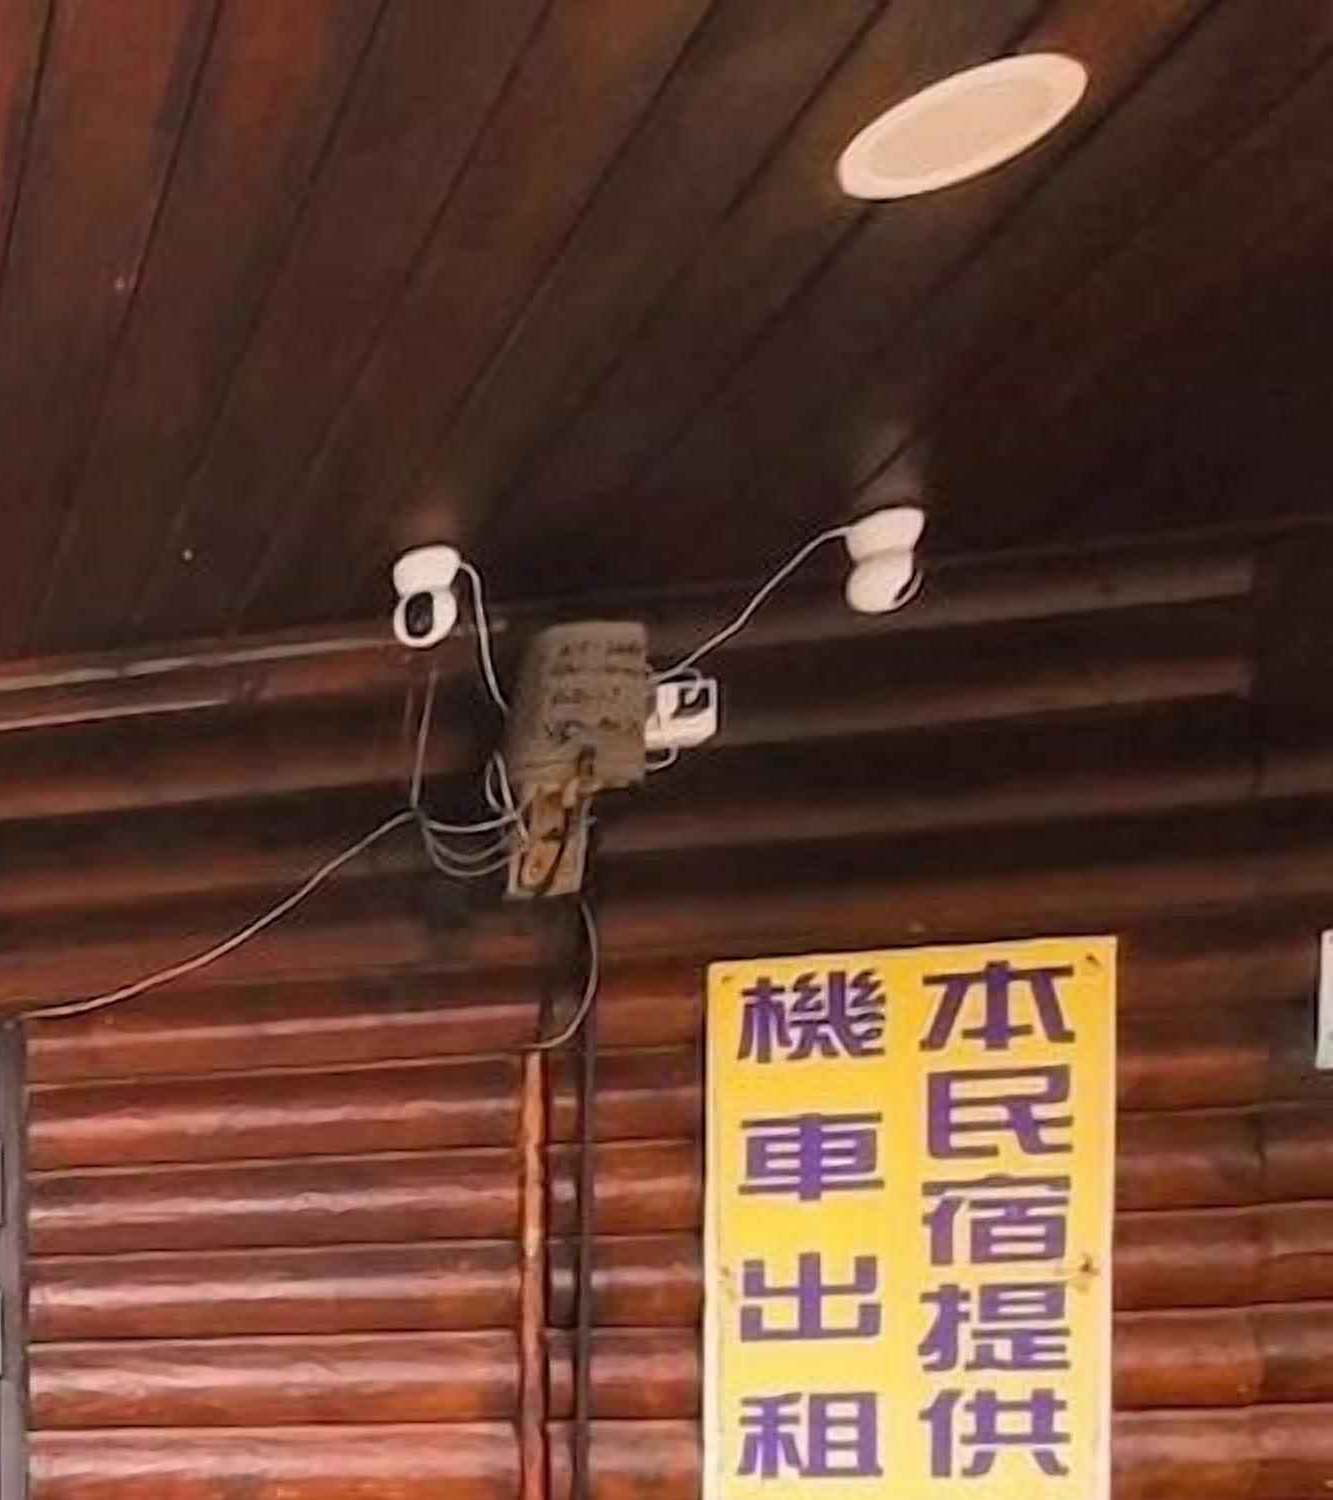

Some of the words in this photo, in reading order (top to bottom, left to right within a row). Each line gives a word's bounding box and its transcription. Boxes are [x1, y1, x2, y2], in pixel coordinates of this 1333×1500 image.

[736, 968, 887, 1481] 機車出租
[918, 959, 1076, 1480] 本民宿提供
